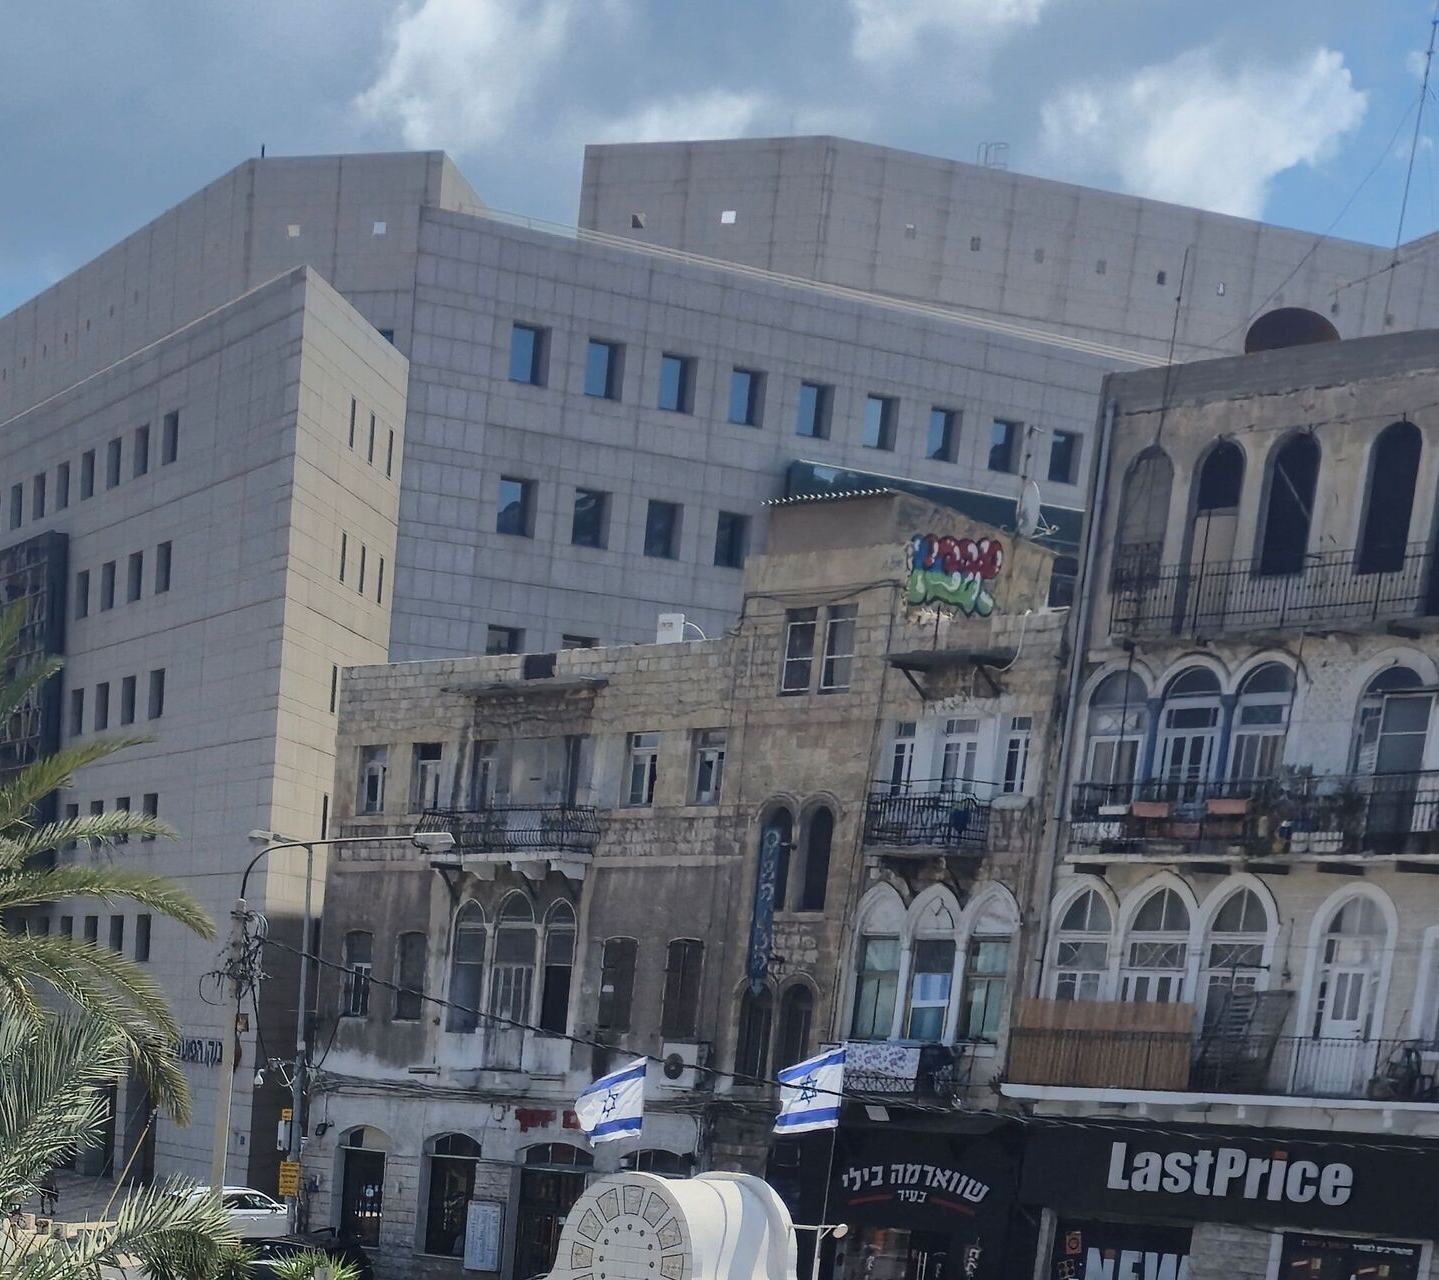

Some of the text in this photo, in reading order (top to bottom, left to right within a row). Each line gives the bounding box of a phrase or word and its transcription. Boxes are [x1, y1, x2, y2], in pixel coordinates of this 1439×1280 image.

[842, 1163, 991, 1203] שווארמה בילי
[1106, 1141, 1354, 1206] LastPrice
